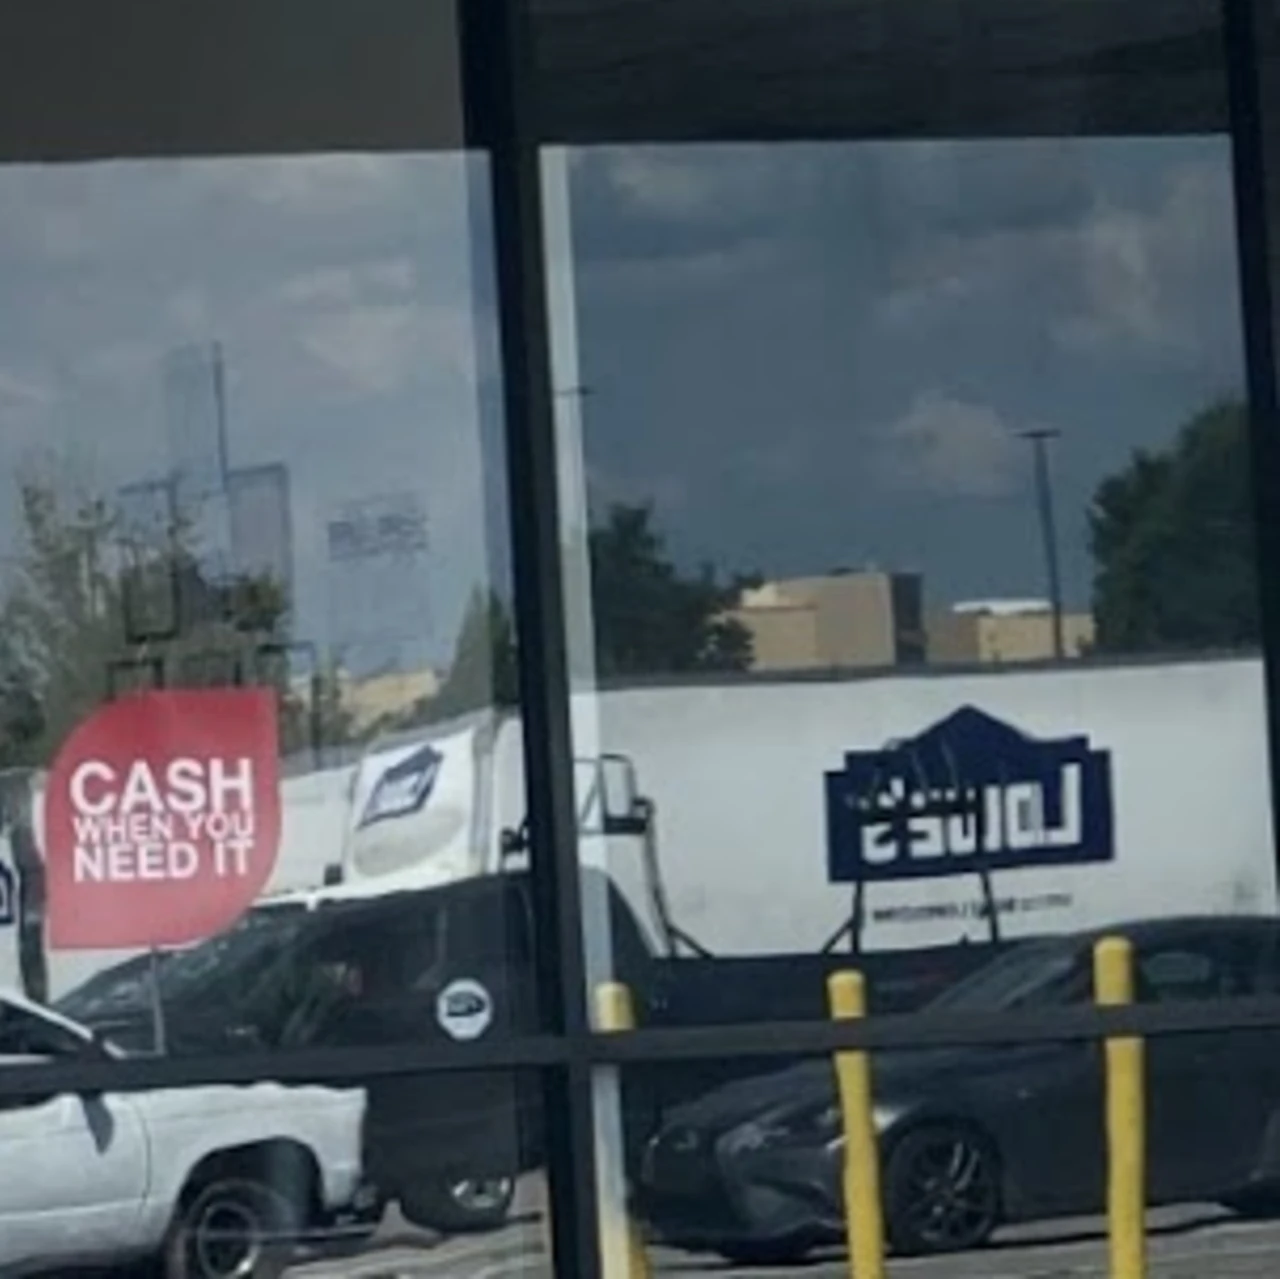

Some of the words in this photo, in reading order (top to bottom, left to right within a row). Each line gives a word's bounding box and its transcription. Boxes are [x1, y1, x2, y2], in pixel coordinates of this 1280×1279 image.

[70, 758, 252, 814] CASH
[72, 812, 173, 844] WHEN
[184, 808, 254, 841] YOU
[73, 842, 199, 882] NEED
[215, 838, 253, 875] IT
